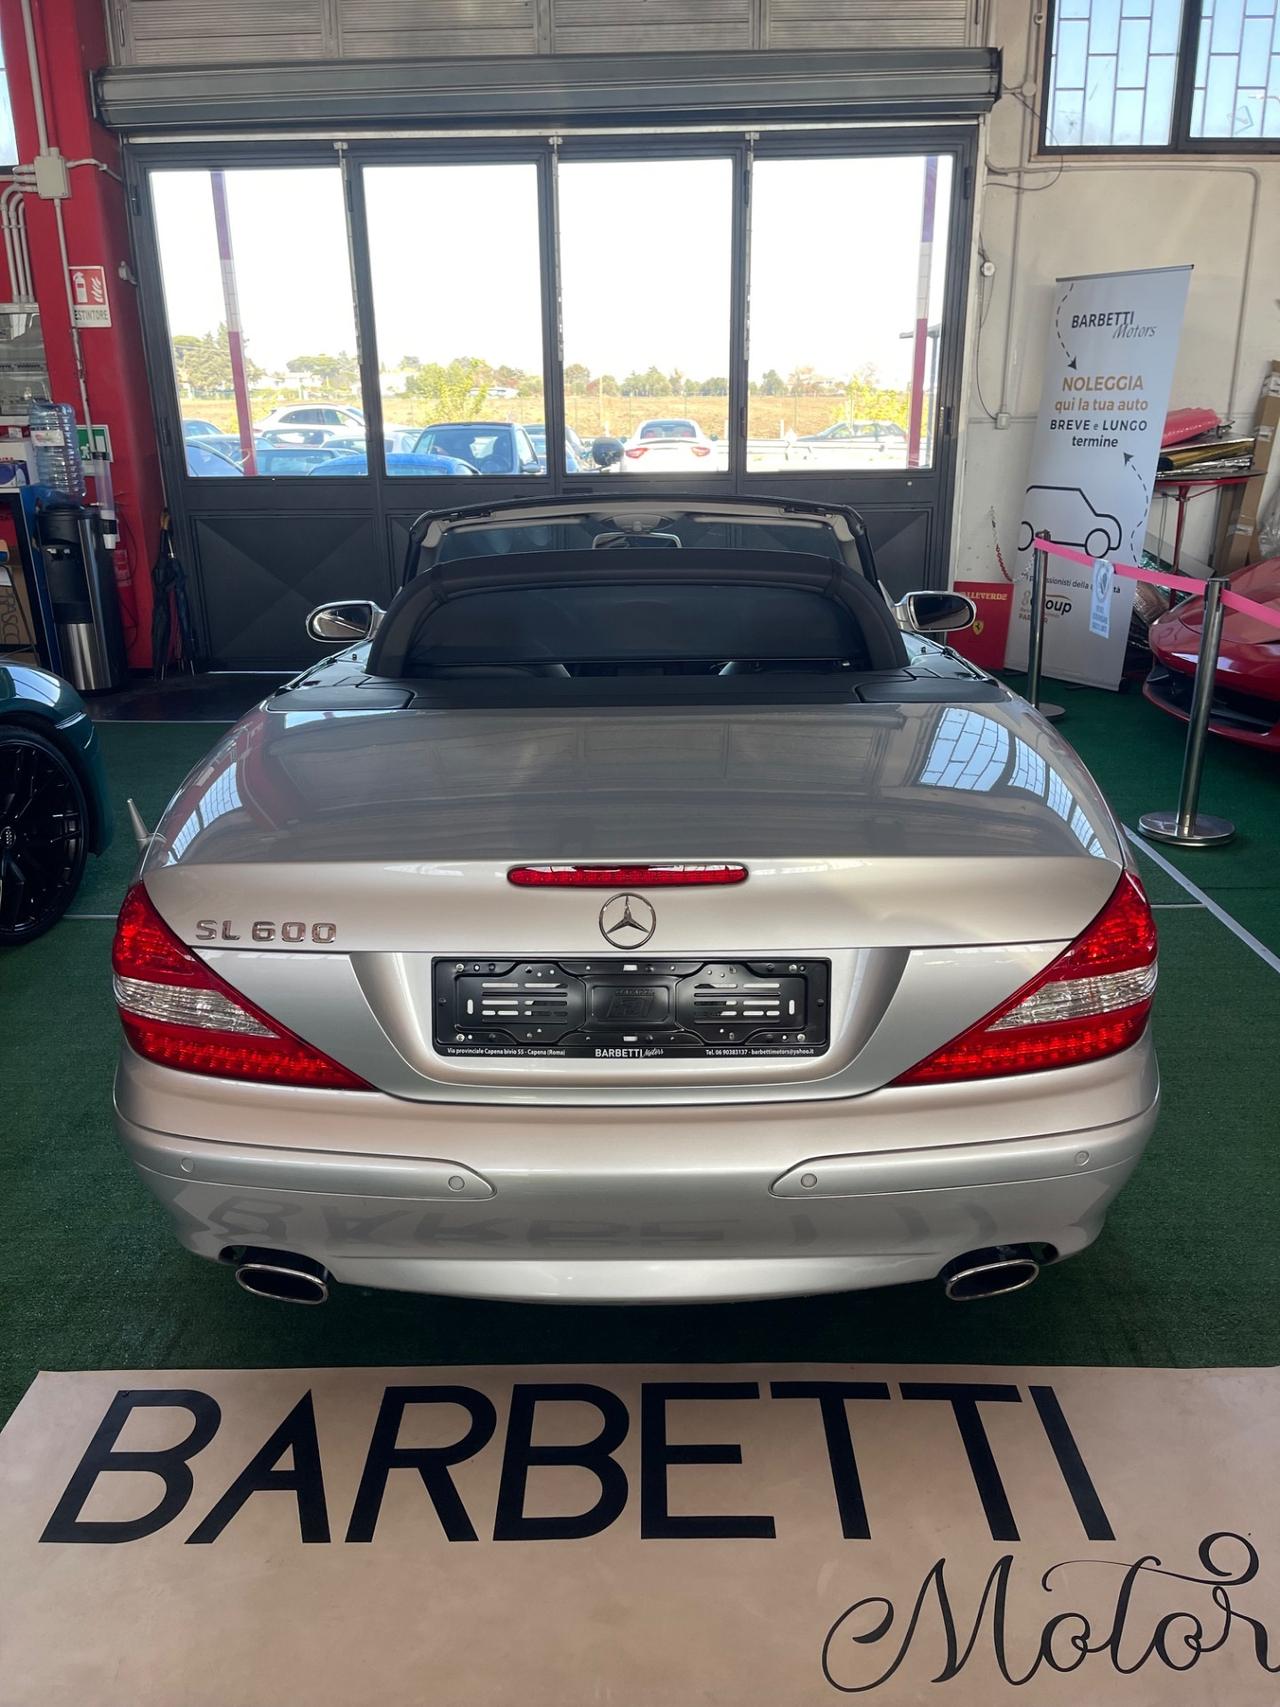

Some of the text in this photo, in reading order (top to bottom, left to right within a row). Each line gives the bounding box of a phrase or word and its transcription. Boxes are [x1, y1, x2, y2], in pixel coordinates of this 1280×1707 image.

[74, 310, 108, 320] ESTINTORE
[1071, 311, 1135, 328] BARBETTI
[1112, 324, 1157, 339] Motors
[1062, 375, 1144, 391] NOLEGGIA
[1055, 398, 1149, 413] qui la tua auto
[1050, 419, 1148, 431] BREVE e LUNGO
[1072, 435, 1119, 447] termine
[195, 919, 337, 944] SL 600
[595, 1048, 643, 1057] BARBETTI
[38, 1381, 1116, 1544] BARBETTI
